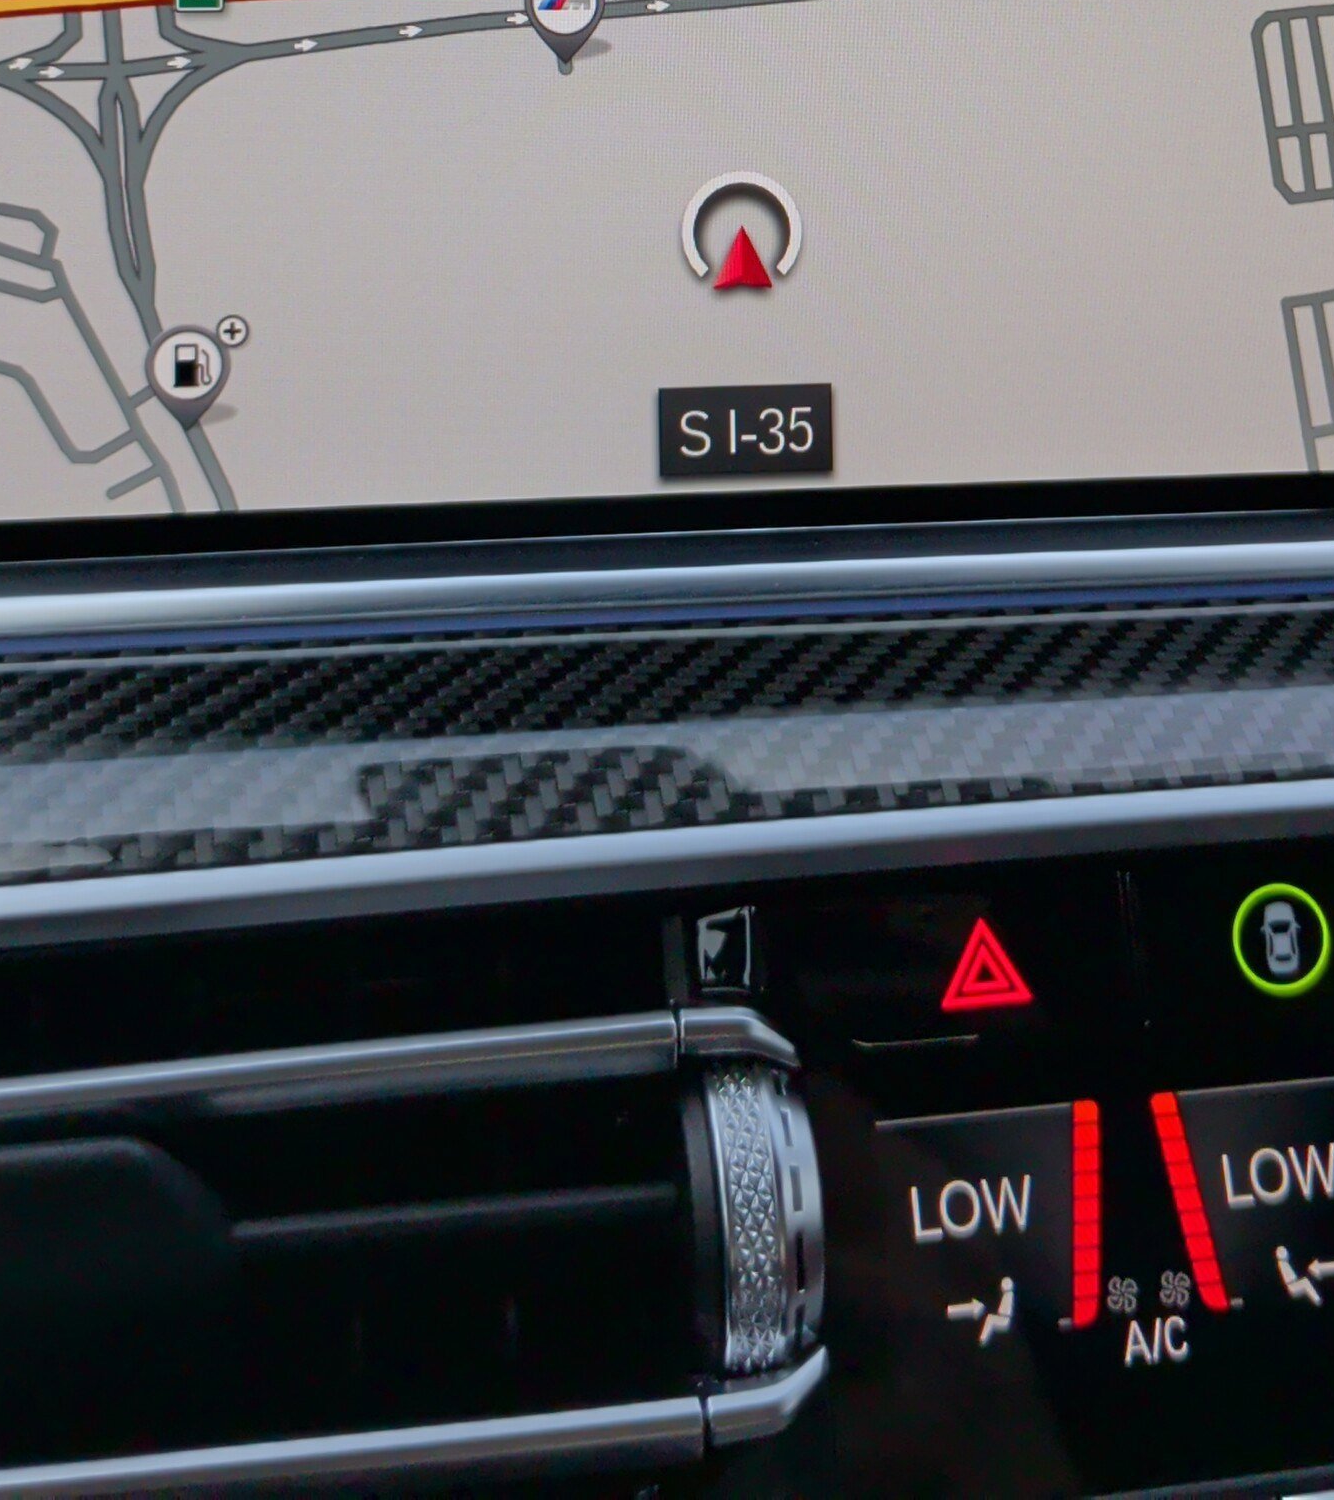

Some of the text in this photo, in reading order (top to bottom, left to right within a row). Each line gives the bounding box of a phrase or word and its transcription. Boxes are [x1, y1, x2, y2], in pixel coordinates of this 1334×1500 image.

[679, 406, 814, 458] S I-35
[910, 1173, 1032, 1244] LOW
[1123, 1314, 1191, 1369] A/C
